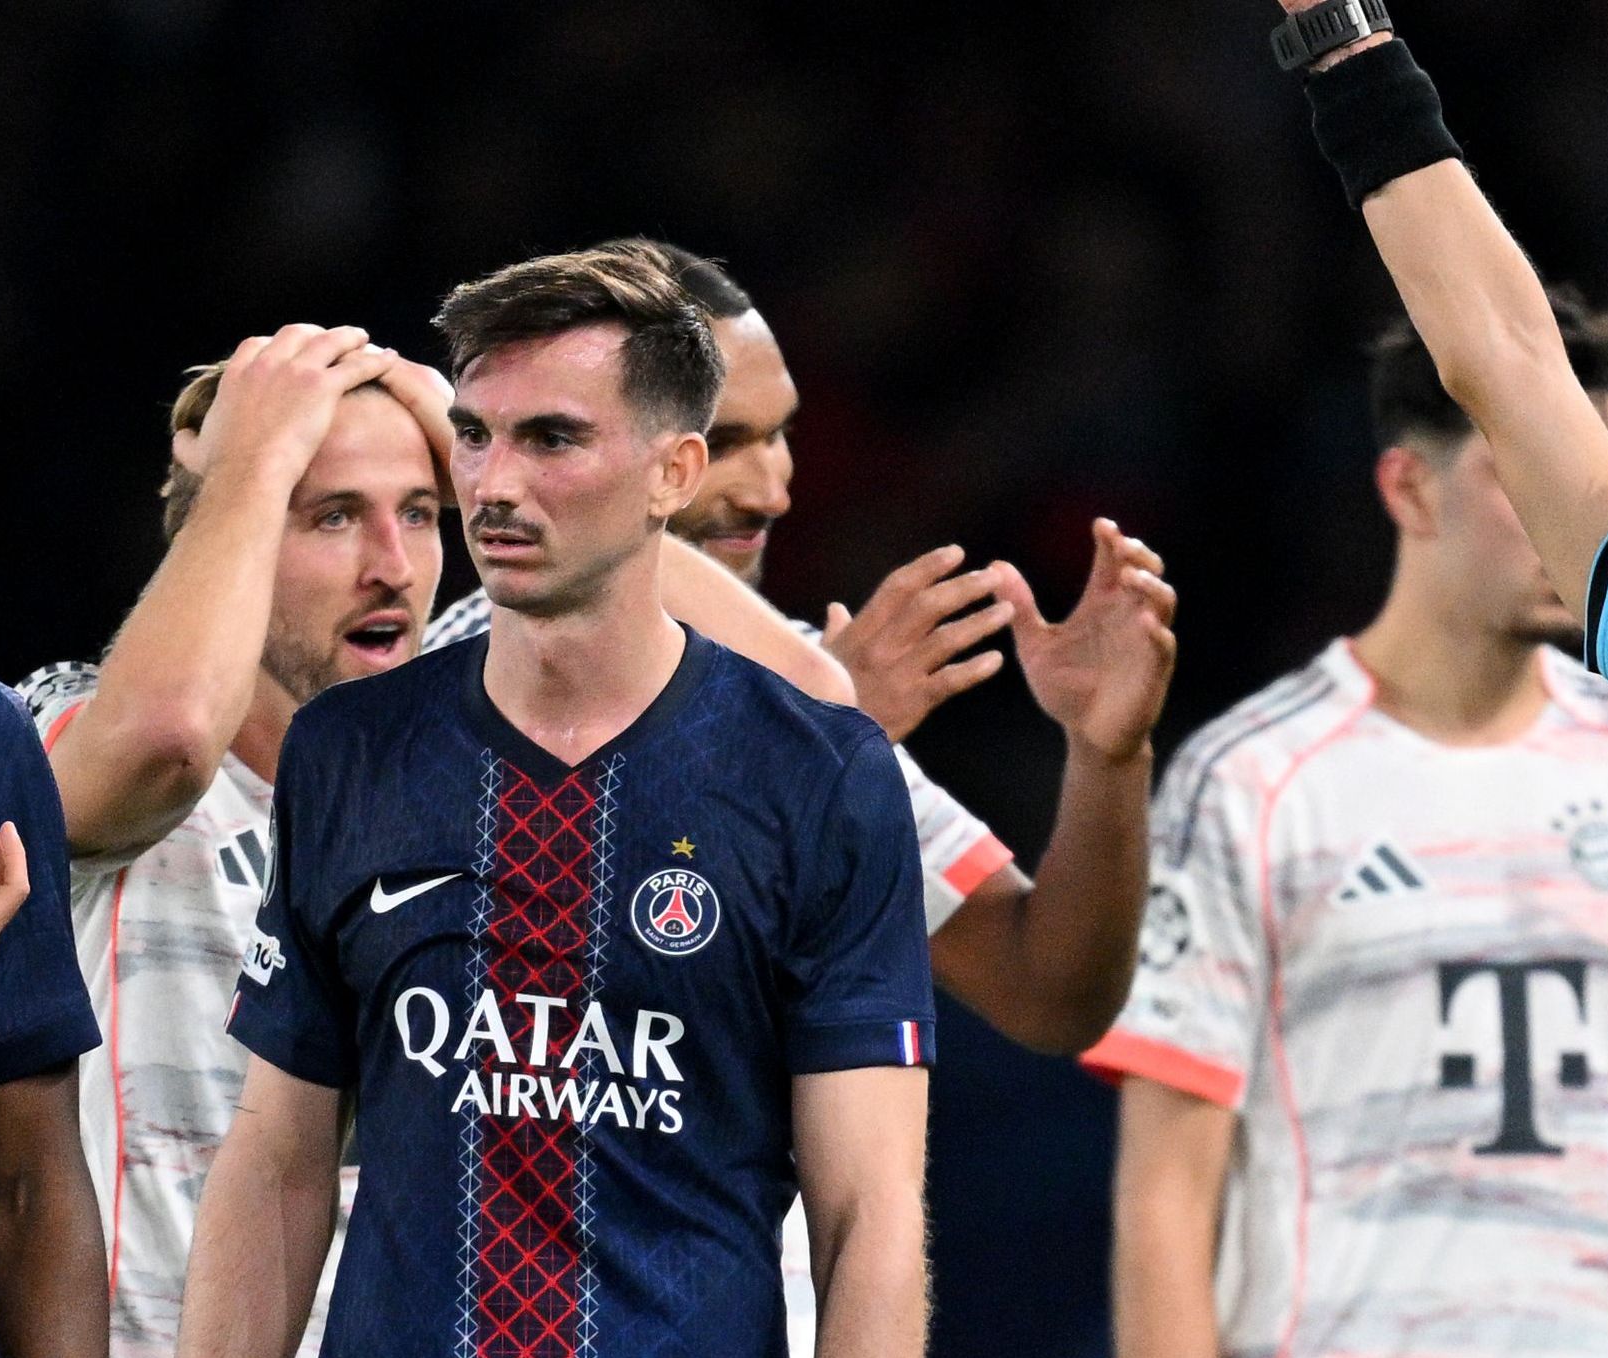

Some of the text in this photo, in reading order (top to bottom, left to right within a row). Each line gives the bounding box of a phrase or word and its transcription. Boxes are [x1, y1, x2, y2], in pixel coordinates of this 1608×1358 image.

[649, 873, 707, 897] PARIS
[394, 987, 686, 1081] QATAR
[451, 1073, 684, 1134] AIRWAYS
